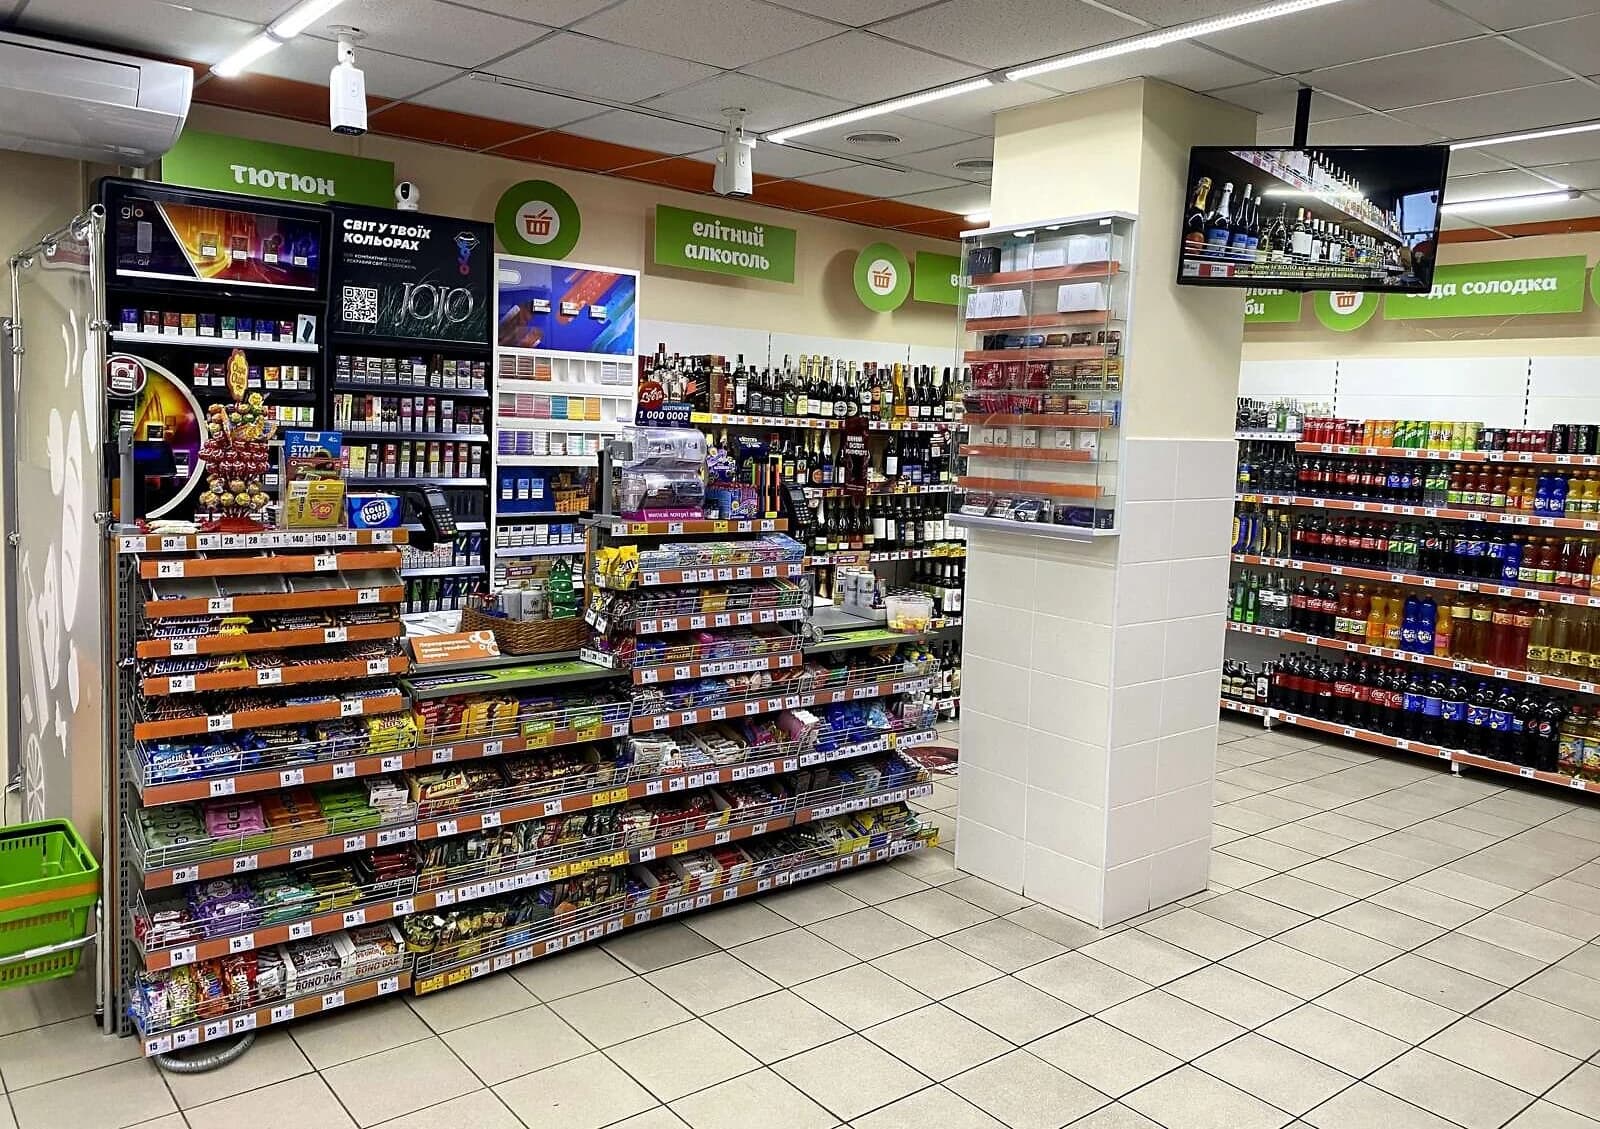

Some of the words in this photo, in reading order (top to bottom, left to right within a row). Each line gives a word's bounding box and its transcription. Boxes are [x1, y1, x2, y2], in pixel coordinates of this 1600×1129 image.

[121, 204, 144, 220] glo
[343, 218, 377, 232] СВІТ
[378, 223, 389, 233] У
[390, 225, 432, 240] ТВОЇХ
[692, 220, 764, 247] елітний
[343, 232, 420, 252] КОЛЬОРАХ
[685, 244, 770, 270] алкоголь
[1406, 282, 1457, 300] да
[1461, 277, 1558, 296] солодка
[638, 411, 644, 420] 1
[646, 411, 665, 420] 000
[290, 445, 323, 453] START
[273, 535, 280, 543] 11
[314, 534, 327, 542] 150
[163, 539, 174, 547] 30
[317, 559, 326, 567] 21
[161, 565, 171, 573] 21
[360, 592, 368, 600] 21
[211, 601, 221, 609] 21
[173, 642, 184, 651] 52
[369, 662, 378, 670] 44
[259, 672, 270, 680] 29
[172, 680, 182, 688] 52
[343, 703, 352, 712] 24
[210, 719, 220, 727] 39
[336, 767, 344, 775] 14
[285, 774, 290, 782] 9
[214, 783, 222, 791] 11
[346, 840, 355, 848] 20
[292, 850, 302, 858] 20
[235, 860, 246, 868] 20
[175, 871, 186, 880] 20
[292, 927, 300, 935] 15
[233, 940, 241, 948] 15
[174, 952, 183, 960] 13
[380, 981, 387, 989] 12
[326, 997, 333, 1005] 12
[275, 1010, 282, 1018] 11
[234, 1019, 245, 1028] 23
[207, 1026, 217, 1036] 23
[177, 1034, 186, 1043] 15
[149, 1043, 158, 1051] 15
